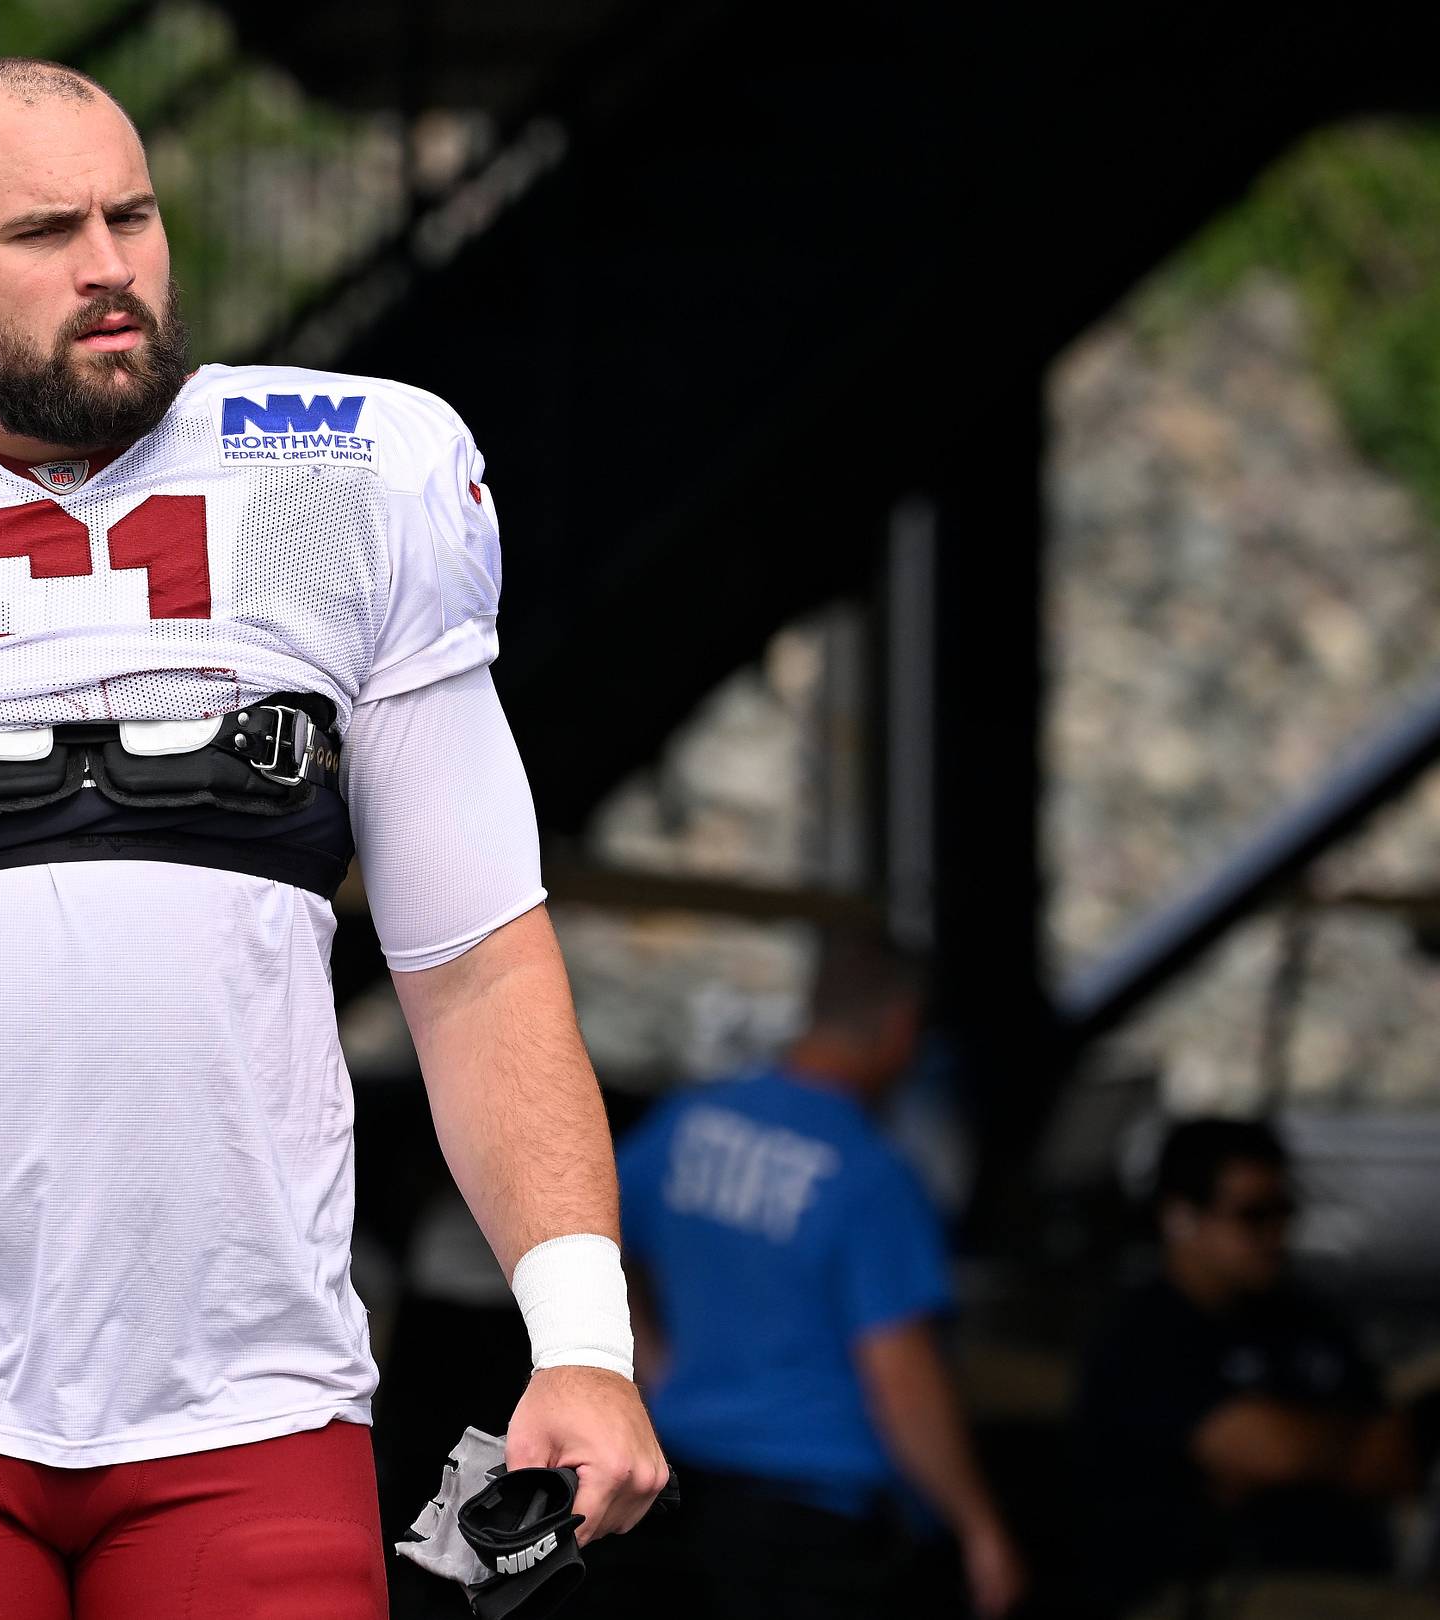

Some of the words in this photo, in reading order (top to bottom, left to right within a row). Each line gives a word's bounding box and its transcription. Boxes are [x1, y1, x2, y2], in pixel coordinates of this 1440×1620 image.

[221, 394, 366, 435] NW
[222, 434, 375, 451] NORTHWEST
[224, 451, 280, 460] FEDERAL
[282, 450, 327, 460] CREDIT
[330, 450, 372, 462] UNION
[53, 474, 73, 483] NFL
[496, 1532, 558, 1575] NIKE
